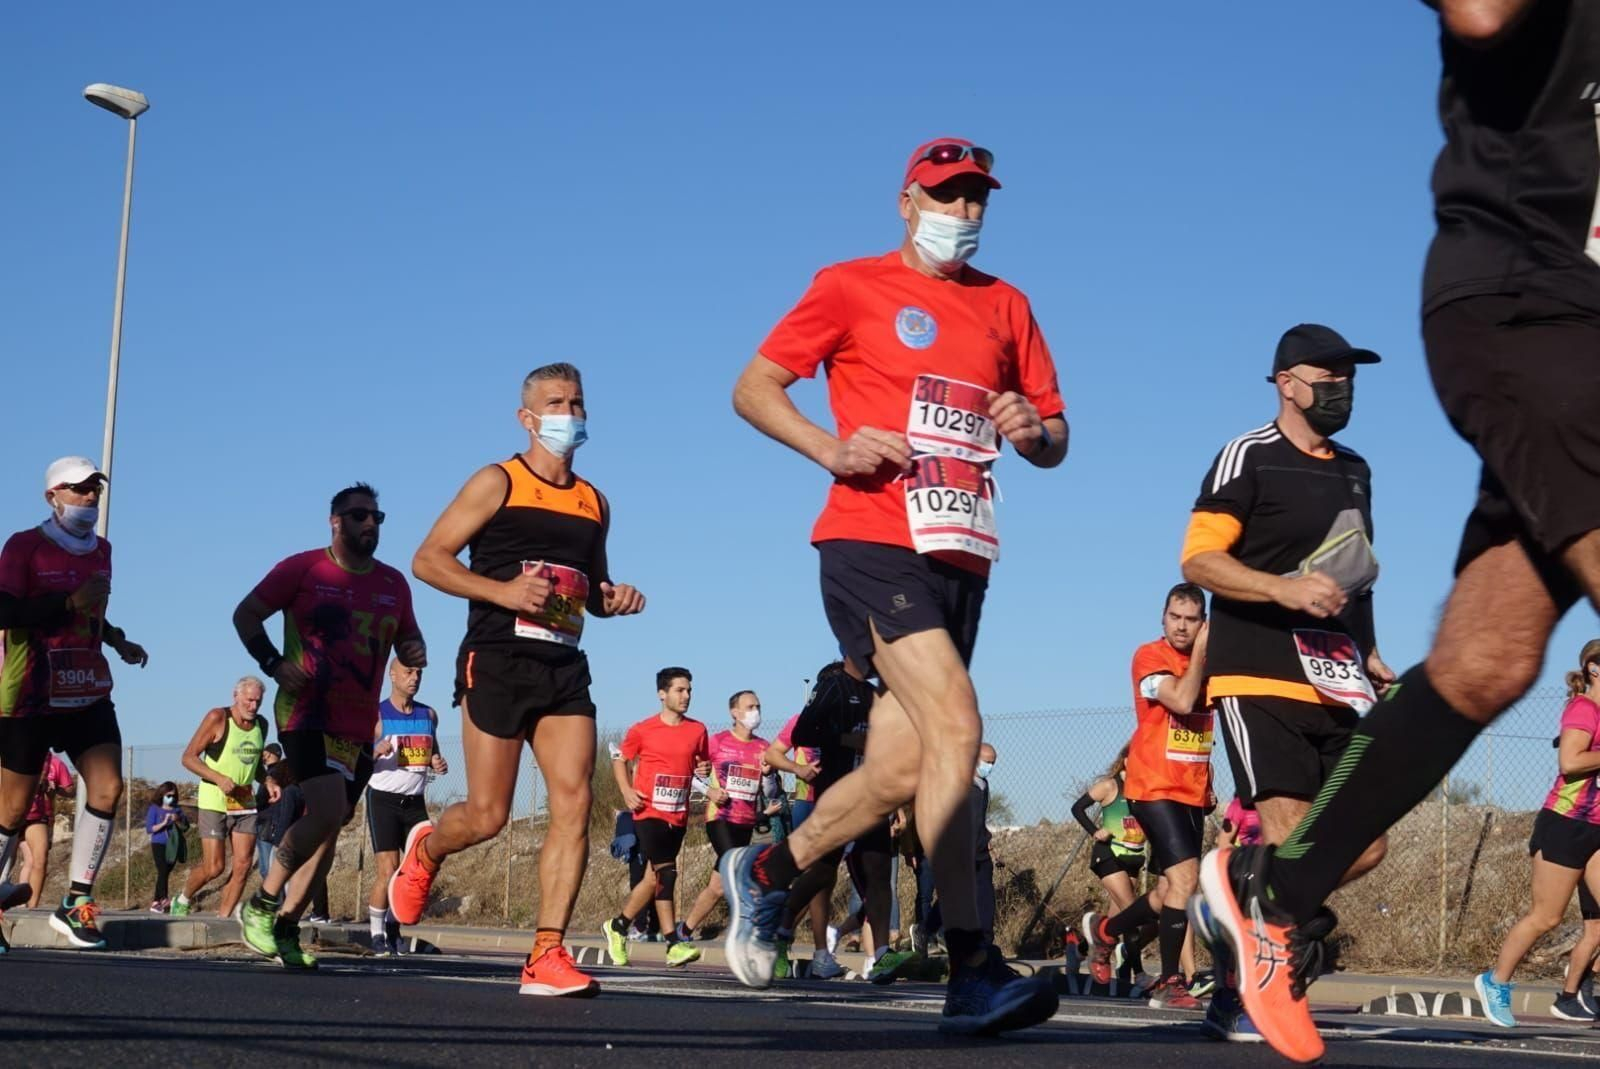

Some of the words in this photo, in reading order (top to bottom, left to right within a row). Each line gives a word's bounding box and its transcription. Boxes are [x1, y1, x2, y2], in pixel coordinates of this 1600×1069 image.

[919, 404, 985, 437] 10297
[910, 489, 978, 517] 10297
[57, 669, 96, 685] 3904
[1310, 659, 1362, 680] 9833
[1174, 729, 1204, 743] 6378
[730, 777, 751, 788] 9604
